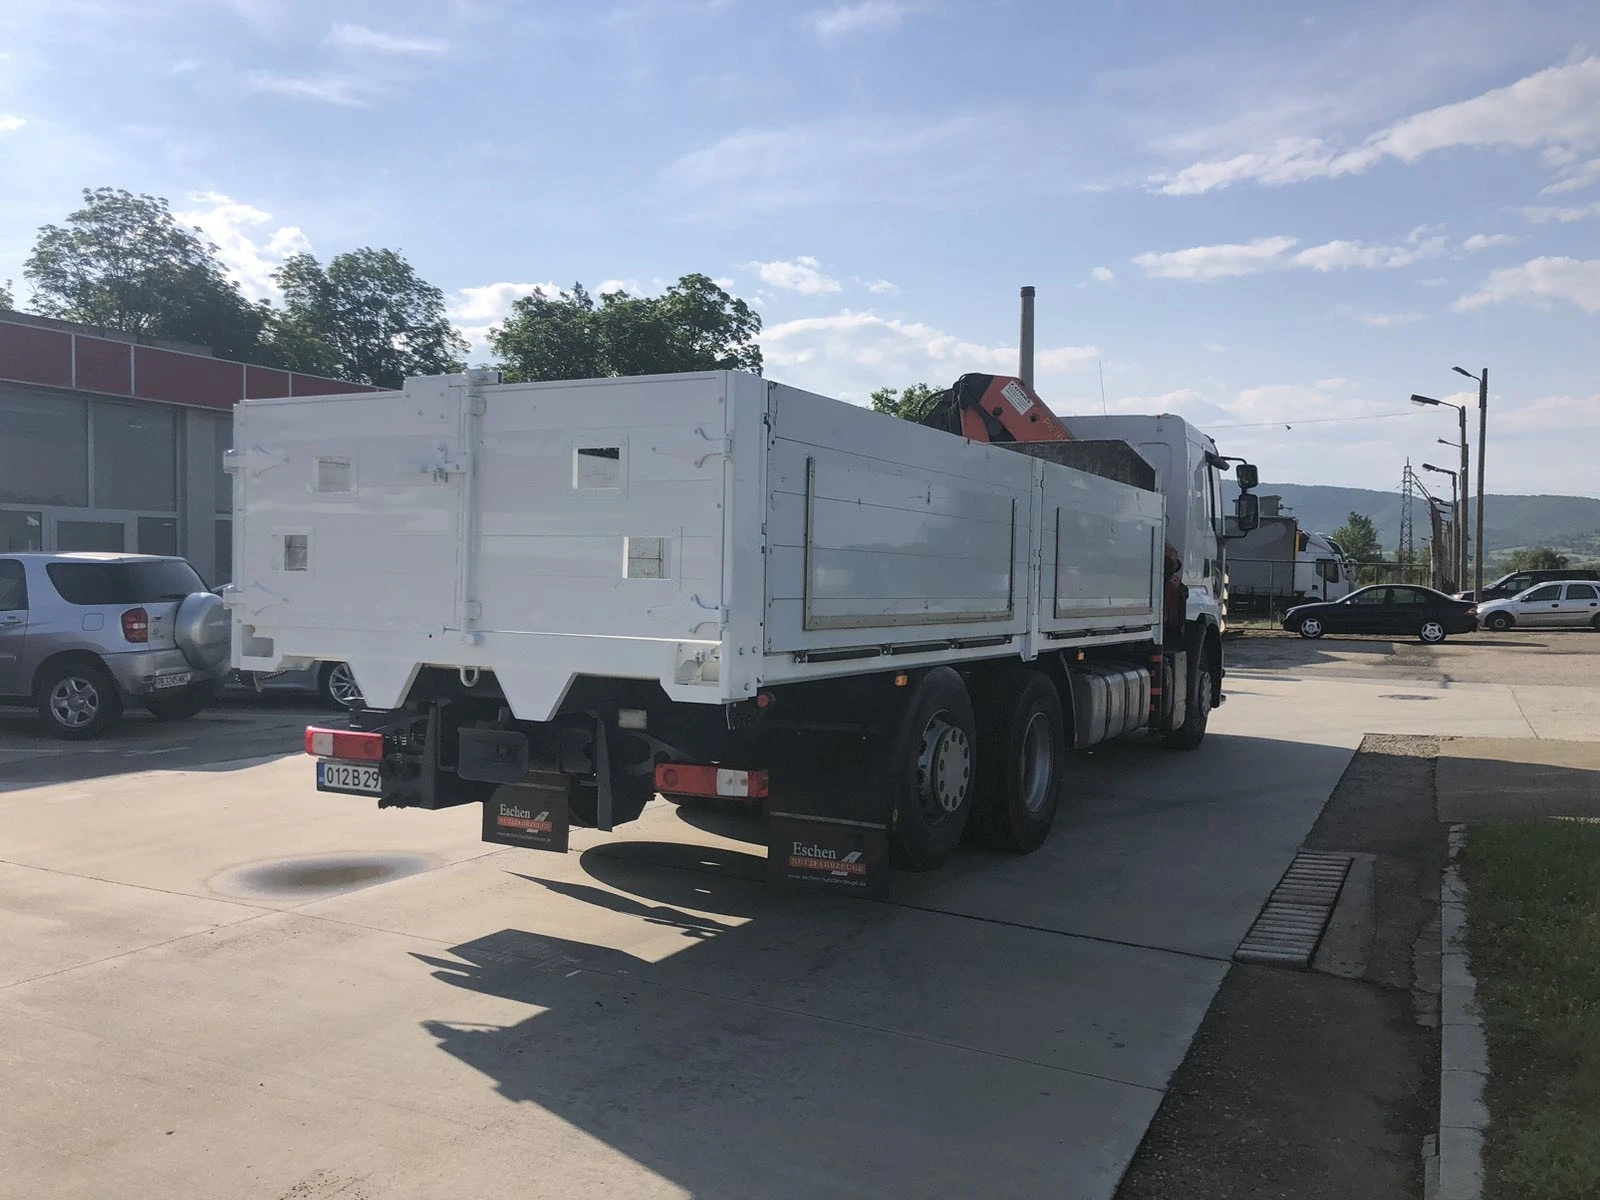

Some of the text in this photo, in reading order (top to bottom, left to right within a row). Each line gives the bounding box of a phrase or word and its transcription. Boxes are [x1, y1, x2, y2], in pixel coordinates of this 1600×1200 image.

[326, 766, 380, 788] 012B29
[500, 803, 531, 818] Eschen
[792, 841, 836, 859] Eschen
[791, 857, 864, 873] NUTZFAHRZEUGE
